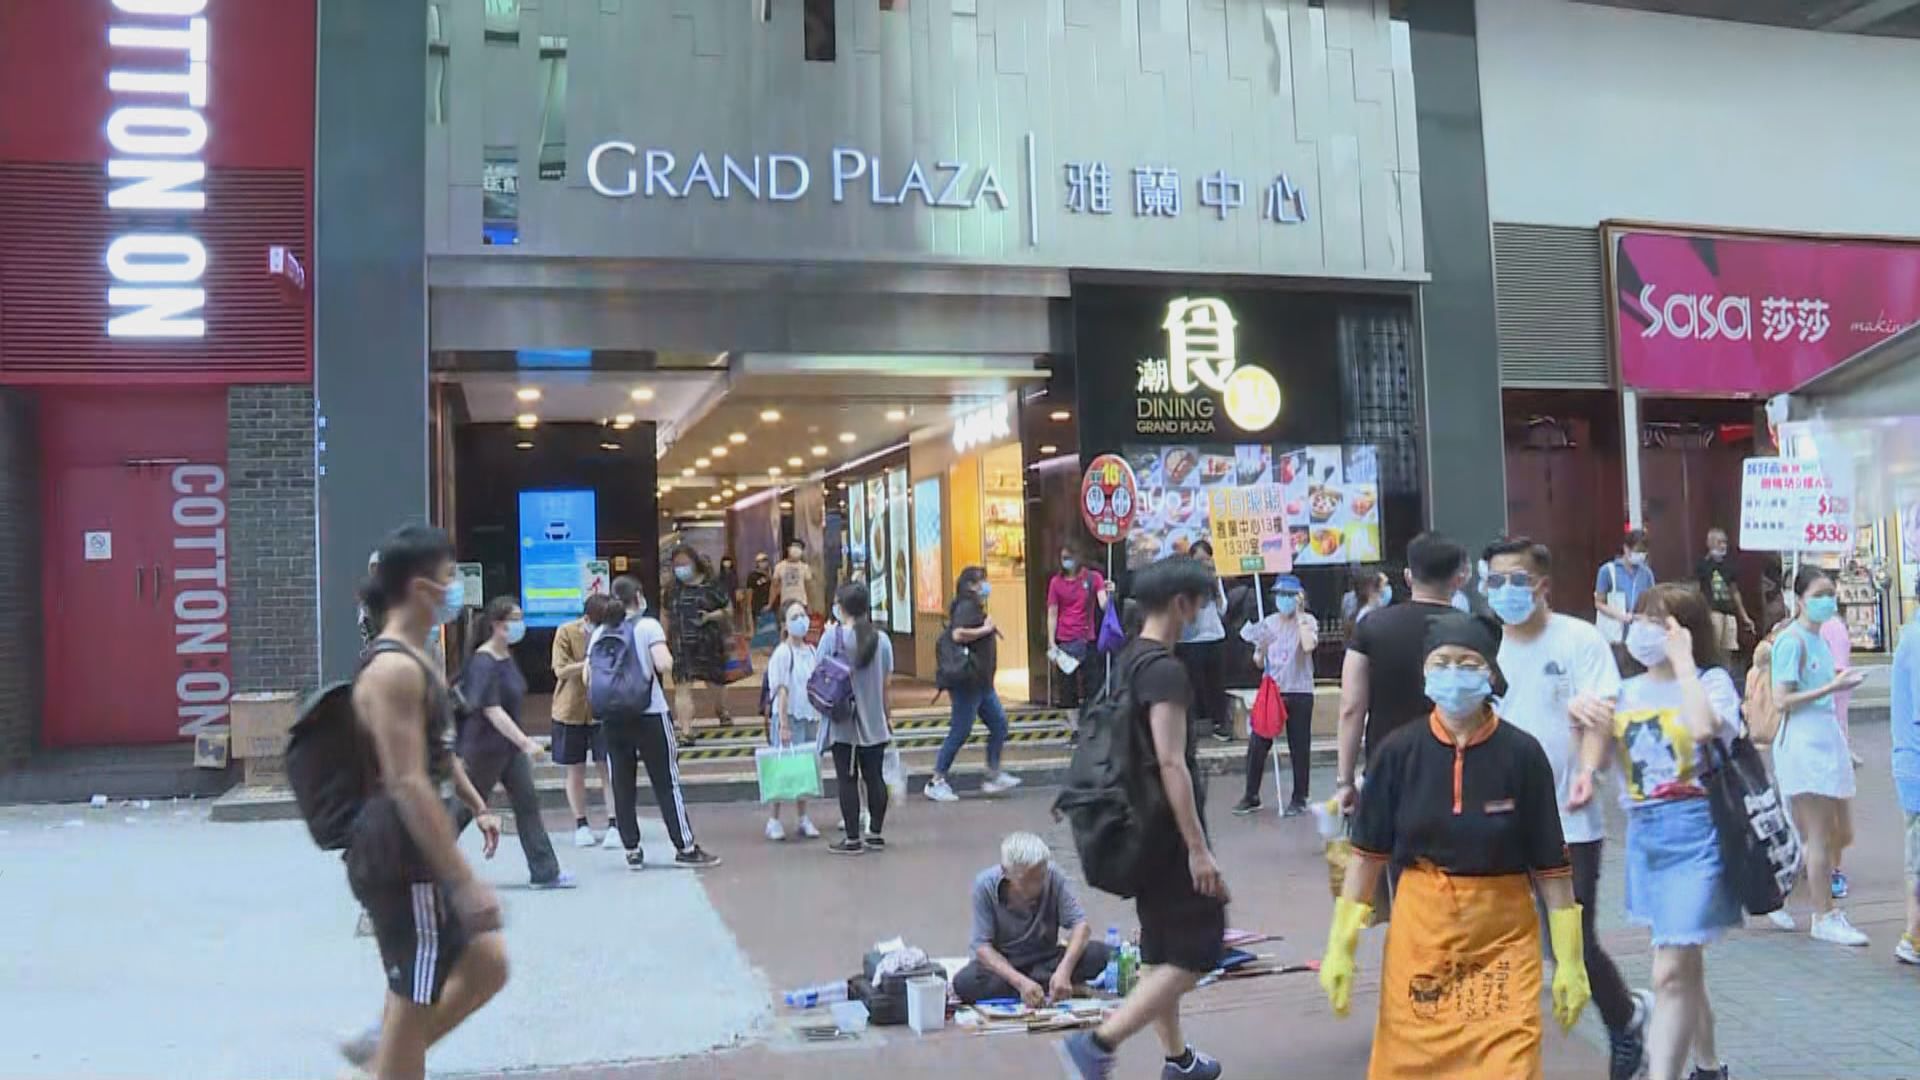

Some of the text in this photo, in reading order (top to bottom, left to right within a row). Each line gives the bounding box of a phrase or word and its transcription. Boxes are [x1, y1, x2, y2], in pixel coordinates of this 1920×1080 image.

[586, 141, 810, 201] GRAND
[831, 147, 1009, 209] PLAZA
[1064, 160, 1310, 224] 雅蘭中心
[1760, 295, 1832, 344] 莎莎
[1137, 398, 1215, 418] DINING
[1137, 420, 1215, 433] GRAND PLAZA
